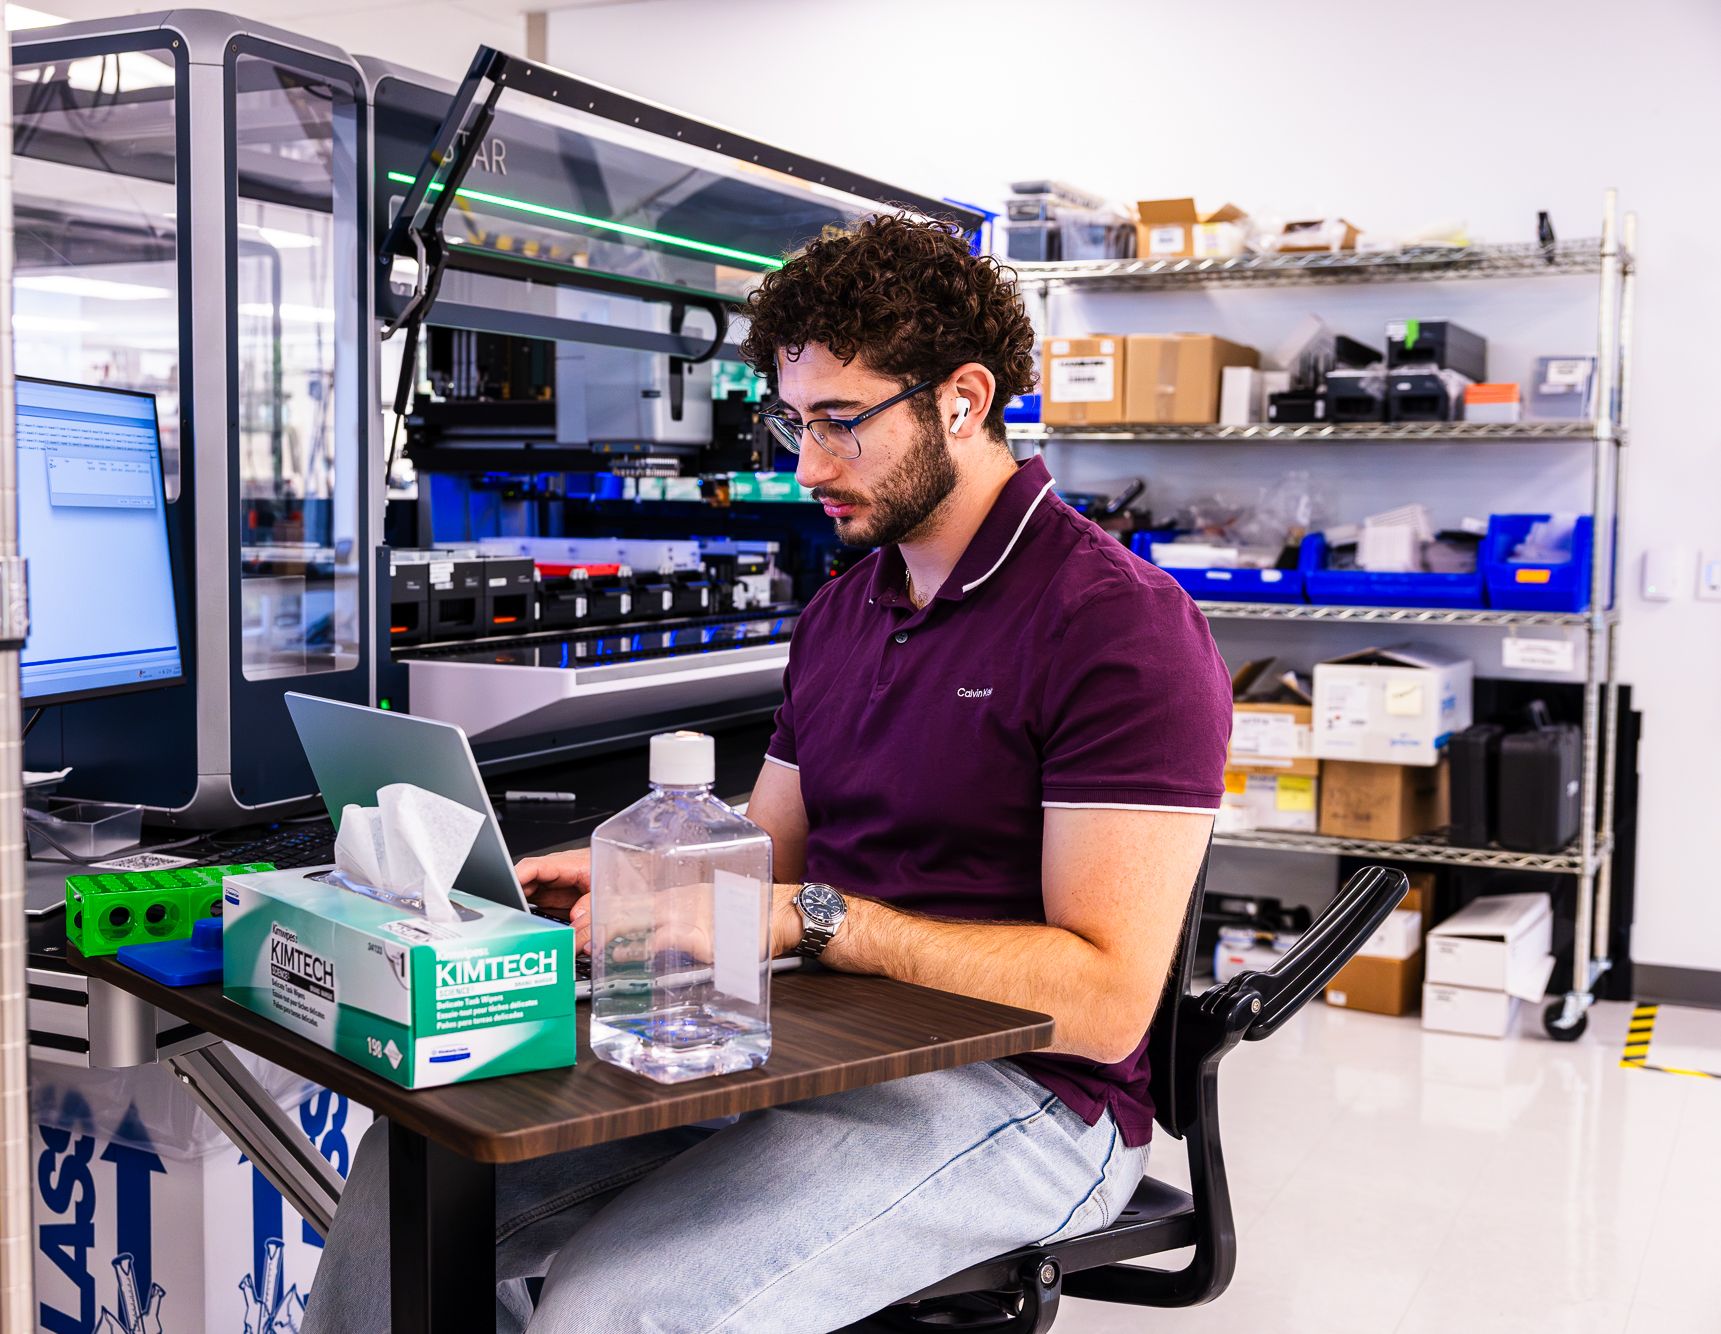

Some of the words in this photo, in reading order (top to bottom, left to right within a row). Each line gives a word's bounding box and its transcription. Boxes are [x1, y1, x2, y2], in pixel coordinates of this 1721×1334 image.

[957, 687, 983, 698] Calvin
[271, 938, 334, 988] KIMTECH
[436, 949, 558, 987] KIMTECH
